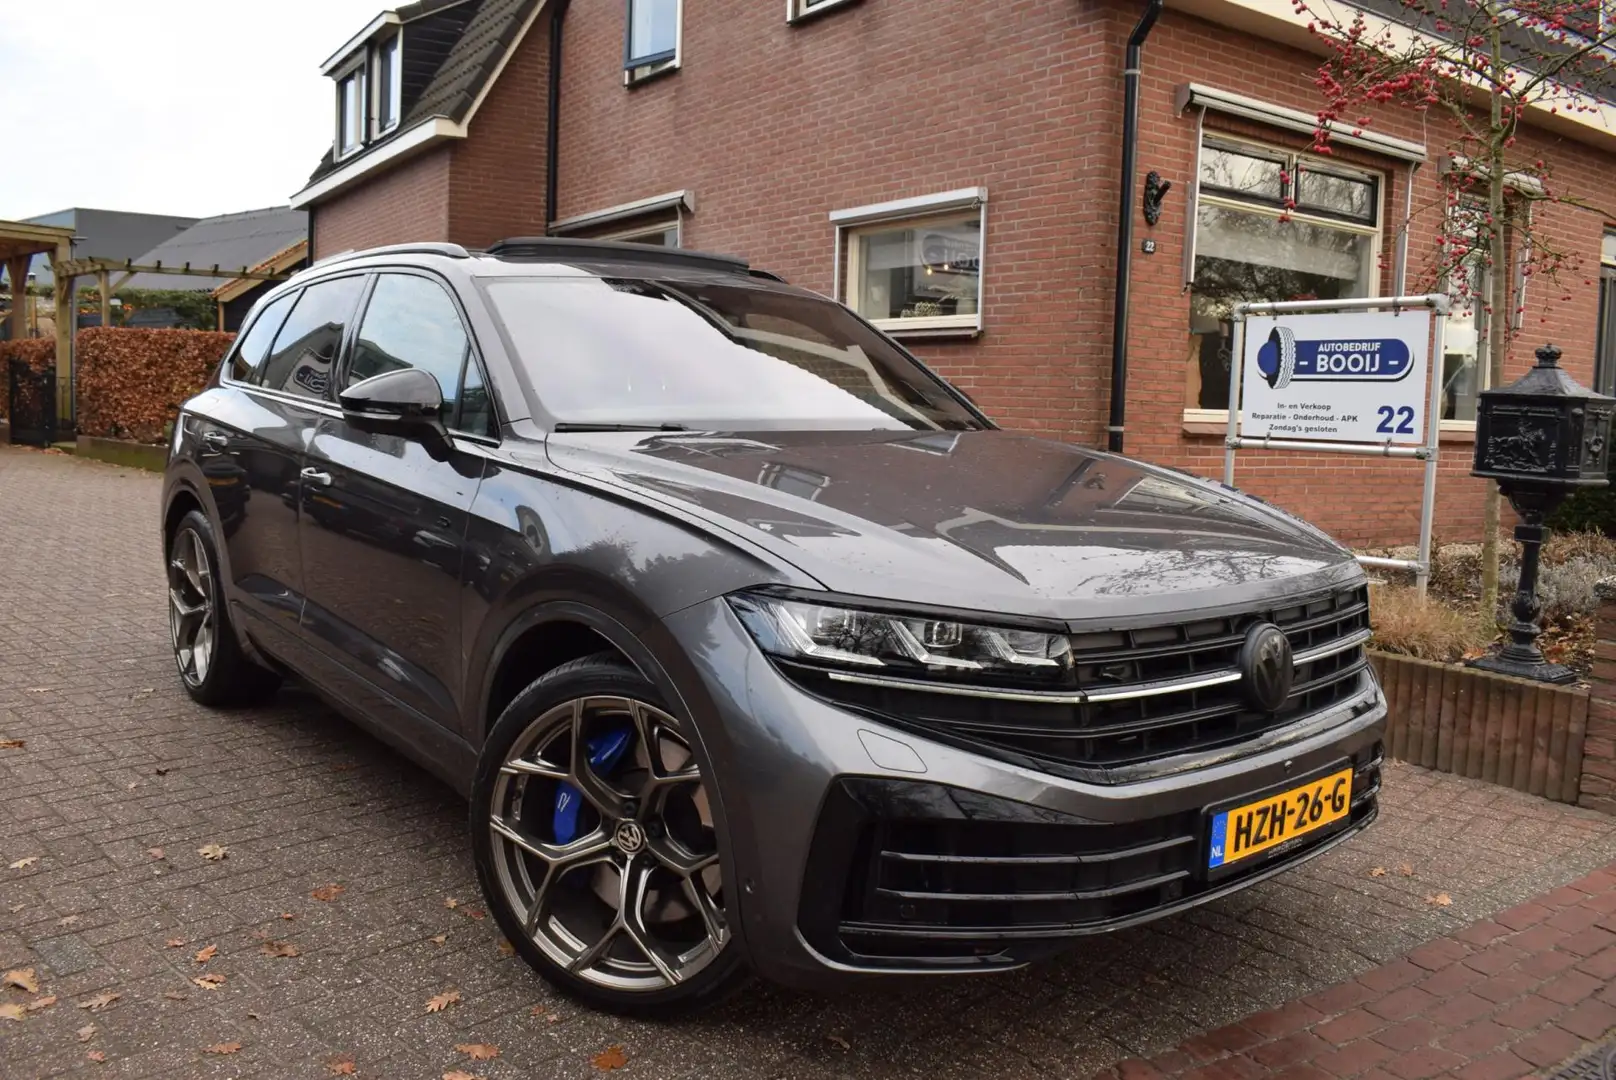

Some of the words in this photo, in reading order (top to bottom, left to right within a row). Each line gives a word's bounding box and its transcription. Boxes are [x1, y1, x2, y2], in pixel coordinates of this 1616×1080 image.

[1144, 240, 1156, 253] 22
[1318, 342, 1381, 352] AUTOBEDRIJF
[1316, 353, 1380, 373] BOOIJ
[1277, 402, 1287, 410] In-
[1300, 402, 1332, 411] Verkoop
[1252, 412, 1287, 421] Reparatie
[1293, 413, 1335, 422] Onderhoud
[1341, 415, 1358, 423] APK
[1376, 405, 1415, 434] 22
[1269, 424, 1302, 433] Zondag's
[1304, 425, 1338, 434] gesloten
[1234, 777, 1346, 853] HZH-26-G
[1210, 845, 1223, 858] NL
